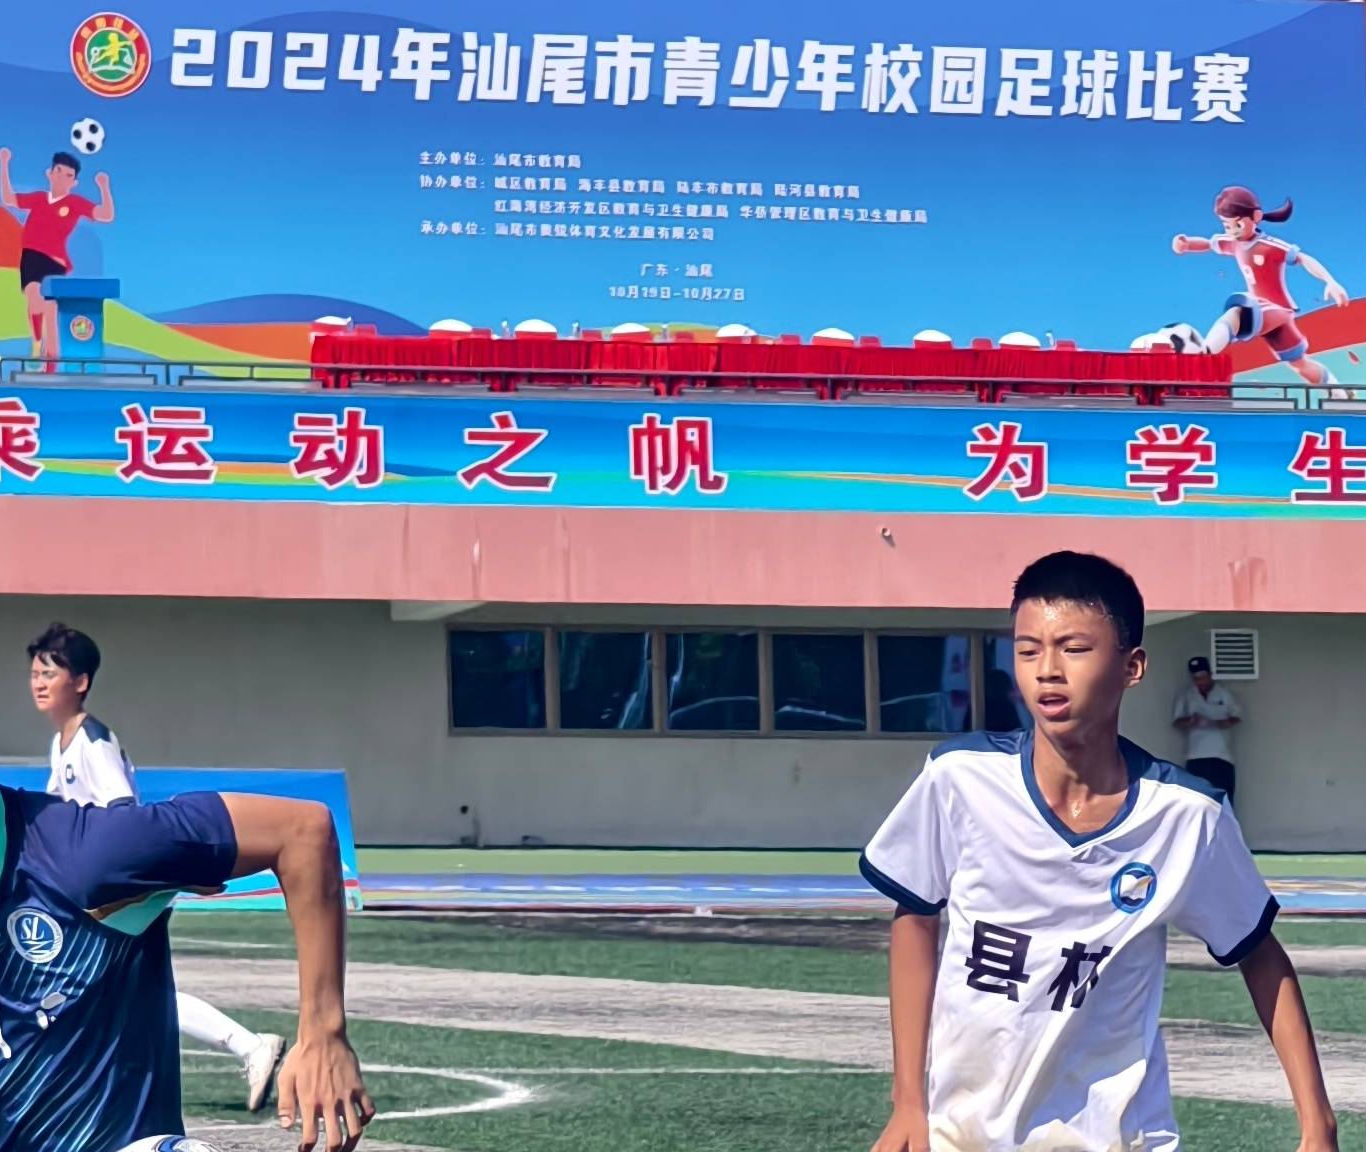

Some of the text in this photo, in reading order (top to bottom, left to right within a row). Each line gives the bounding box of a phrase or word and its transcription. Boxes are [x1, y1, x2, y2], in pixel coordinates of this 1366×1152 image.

[170, 27, 1251, 123] 2024年汕尾市青少年校园足球比赛
[492, 152, 582, 169] 汕尾市教育局
